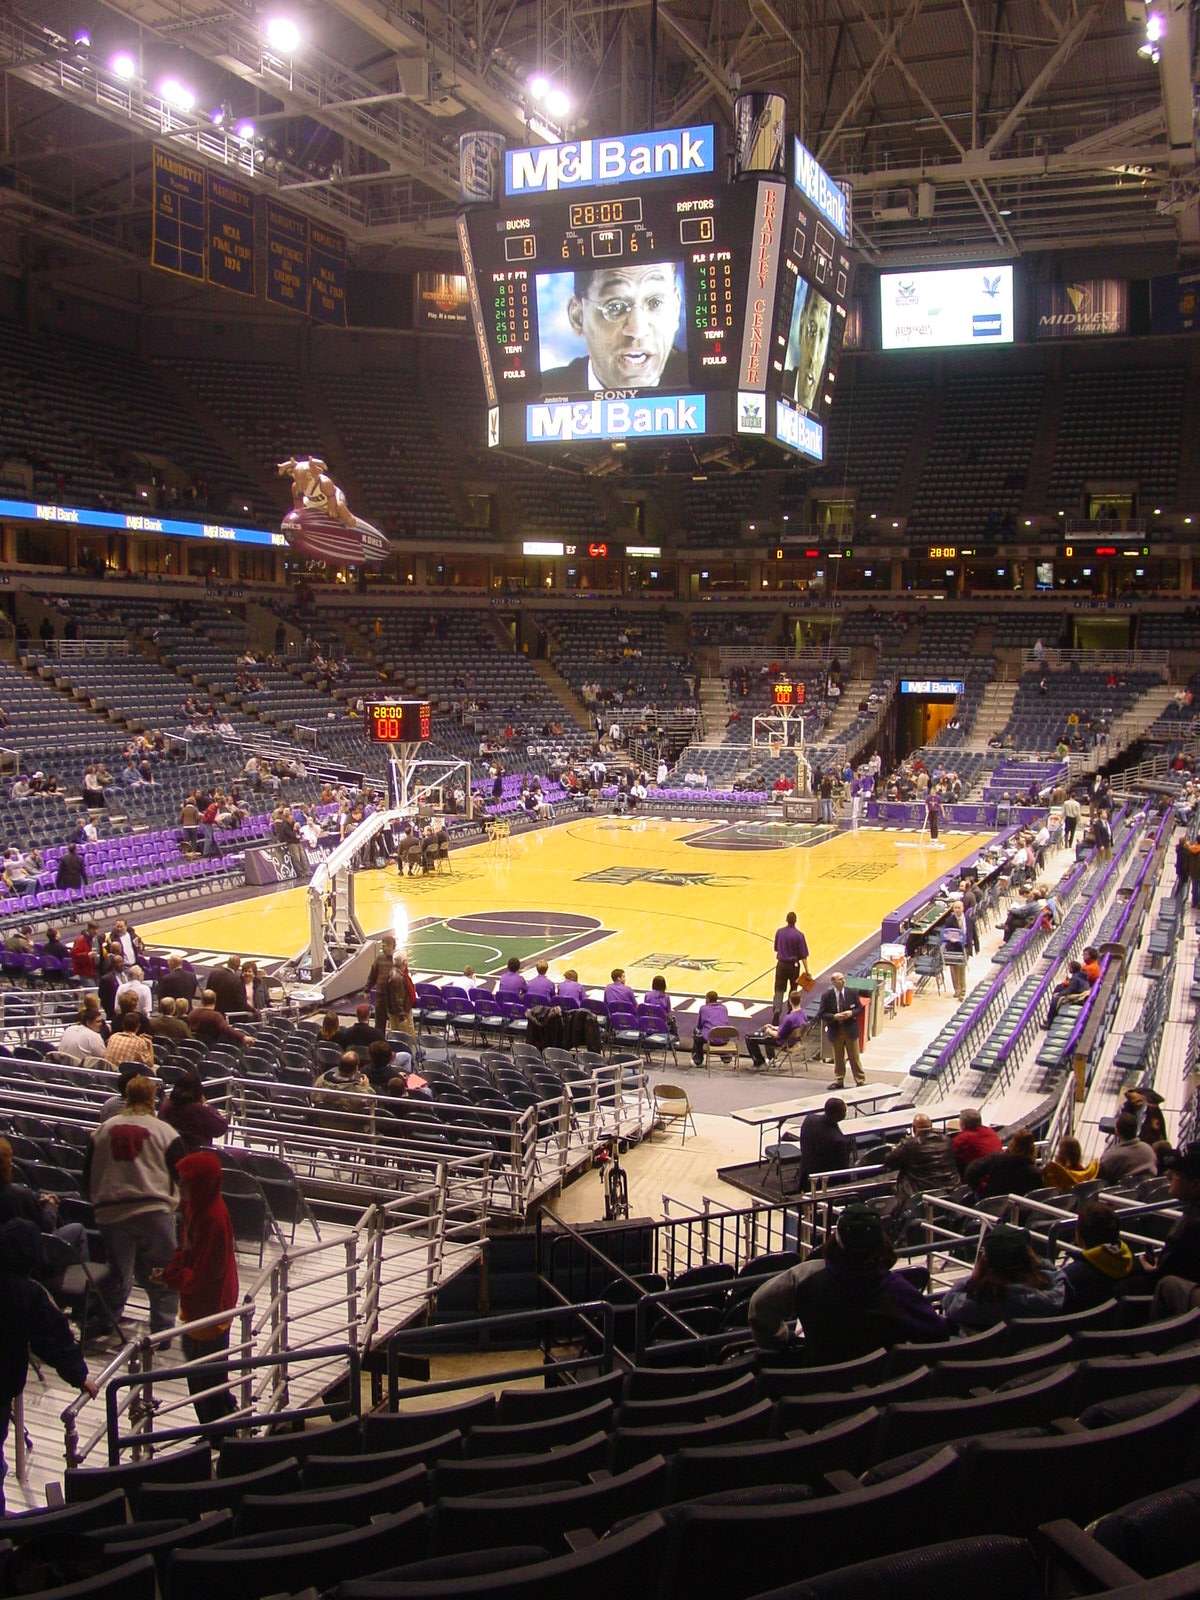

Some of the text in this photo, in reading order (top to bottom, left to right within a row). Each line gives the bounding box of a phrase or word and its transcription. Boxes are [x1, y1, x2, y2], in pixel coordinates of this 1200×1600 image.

[511, 139, 593, 191] M&I
[599, 132, 705, 179] Bank
[799, 152, 820, 199] M&I
[820, 177, 845, 230] Bank
[676, 199, 714, 212] RAPTORS
[573, 203, 623, 225] 28:00
[506, 218, 530, 230] BUCKS
[700, 220, 711, 239] 0
[599, 232, 614, 240] QTR
[524, 238, 533, 256] 0
[562, 245, 570, 258] 6
[630, 239, 638, 252] 6
[693, 252, 731, 263] PLR F PTS
[493, 271, 527, 281] PLR F PTS
[699, 265, 730, 276] 4 0 0
[499, 283, 527, 295] 8 0 0
[700, 278, 731, 289] 5 0 0
[747, 190, 776, 384] BRADLEY CENTER
[495, 295, 527, 307] 22 0 0
[698, 291, 731, 302] 11 0 0
[495, 307, 528, 319] 24 0 0
[696, 303, 732, 315] 24 0 0
[696, 316, 732, 328] 55 0 0
[1040, 311, 1121, 326] MIDWEST
[496, 320, 529, 332] 25 0 0
[496, 332, 529, 343] 50 0 0
[704, 330, 724, 339] TEAM
[504, 345, 522, 354] TEAM
[477, 321, 496, 401] CENTER
[702, 356, 727, 366] FOULS
[504, 370, 526, 379] FOULS
[594, 390, 638, 401] SONY
[532, 400, 698, 440] M&I Bank
[799, 418, 822, 459] Bank
[36, 504, 79, 522] M&I Bank
[126, 516, 163, 531] M&I Bank
[219, 526, 236, 539] Bank
[776, 549, 783, 559] 0
[930, 547, 956, 558] 28:00
[1065, 547, 1073, 557] 0
[909, 681, 958, 694] M&I Bank
[373, 706, 403, 719] 28:00
[378, 719, 399, 738] 00
